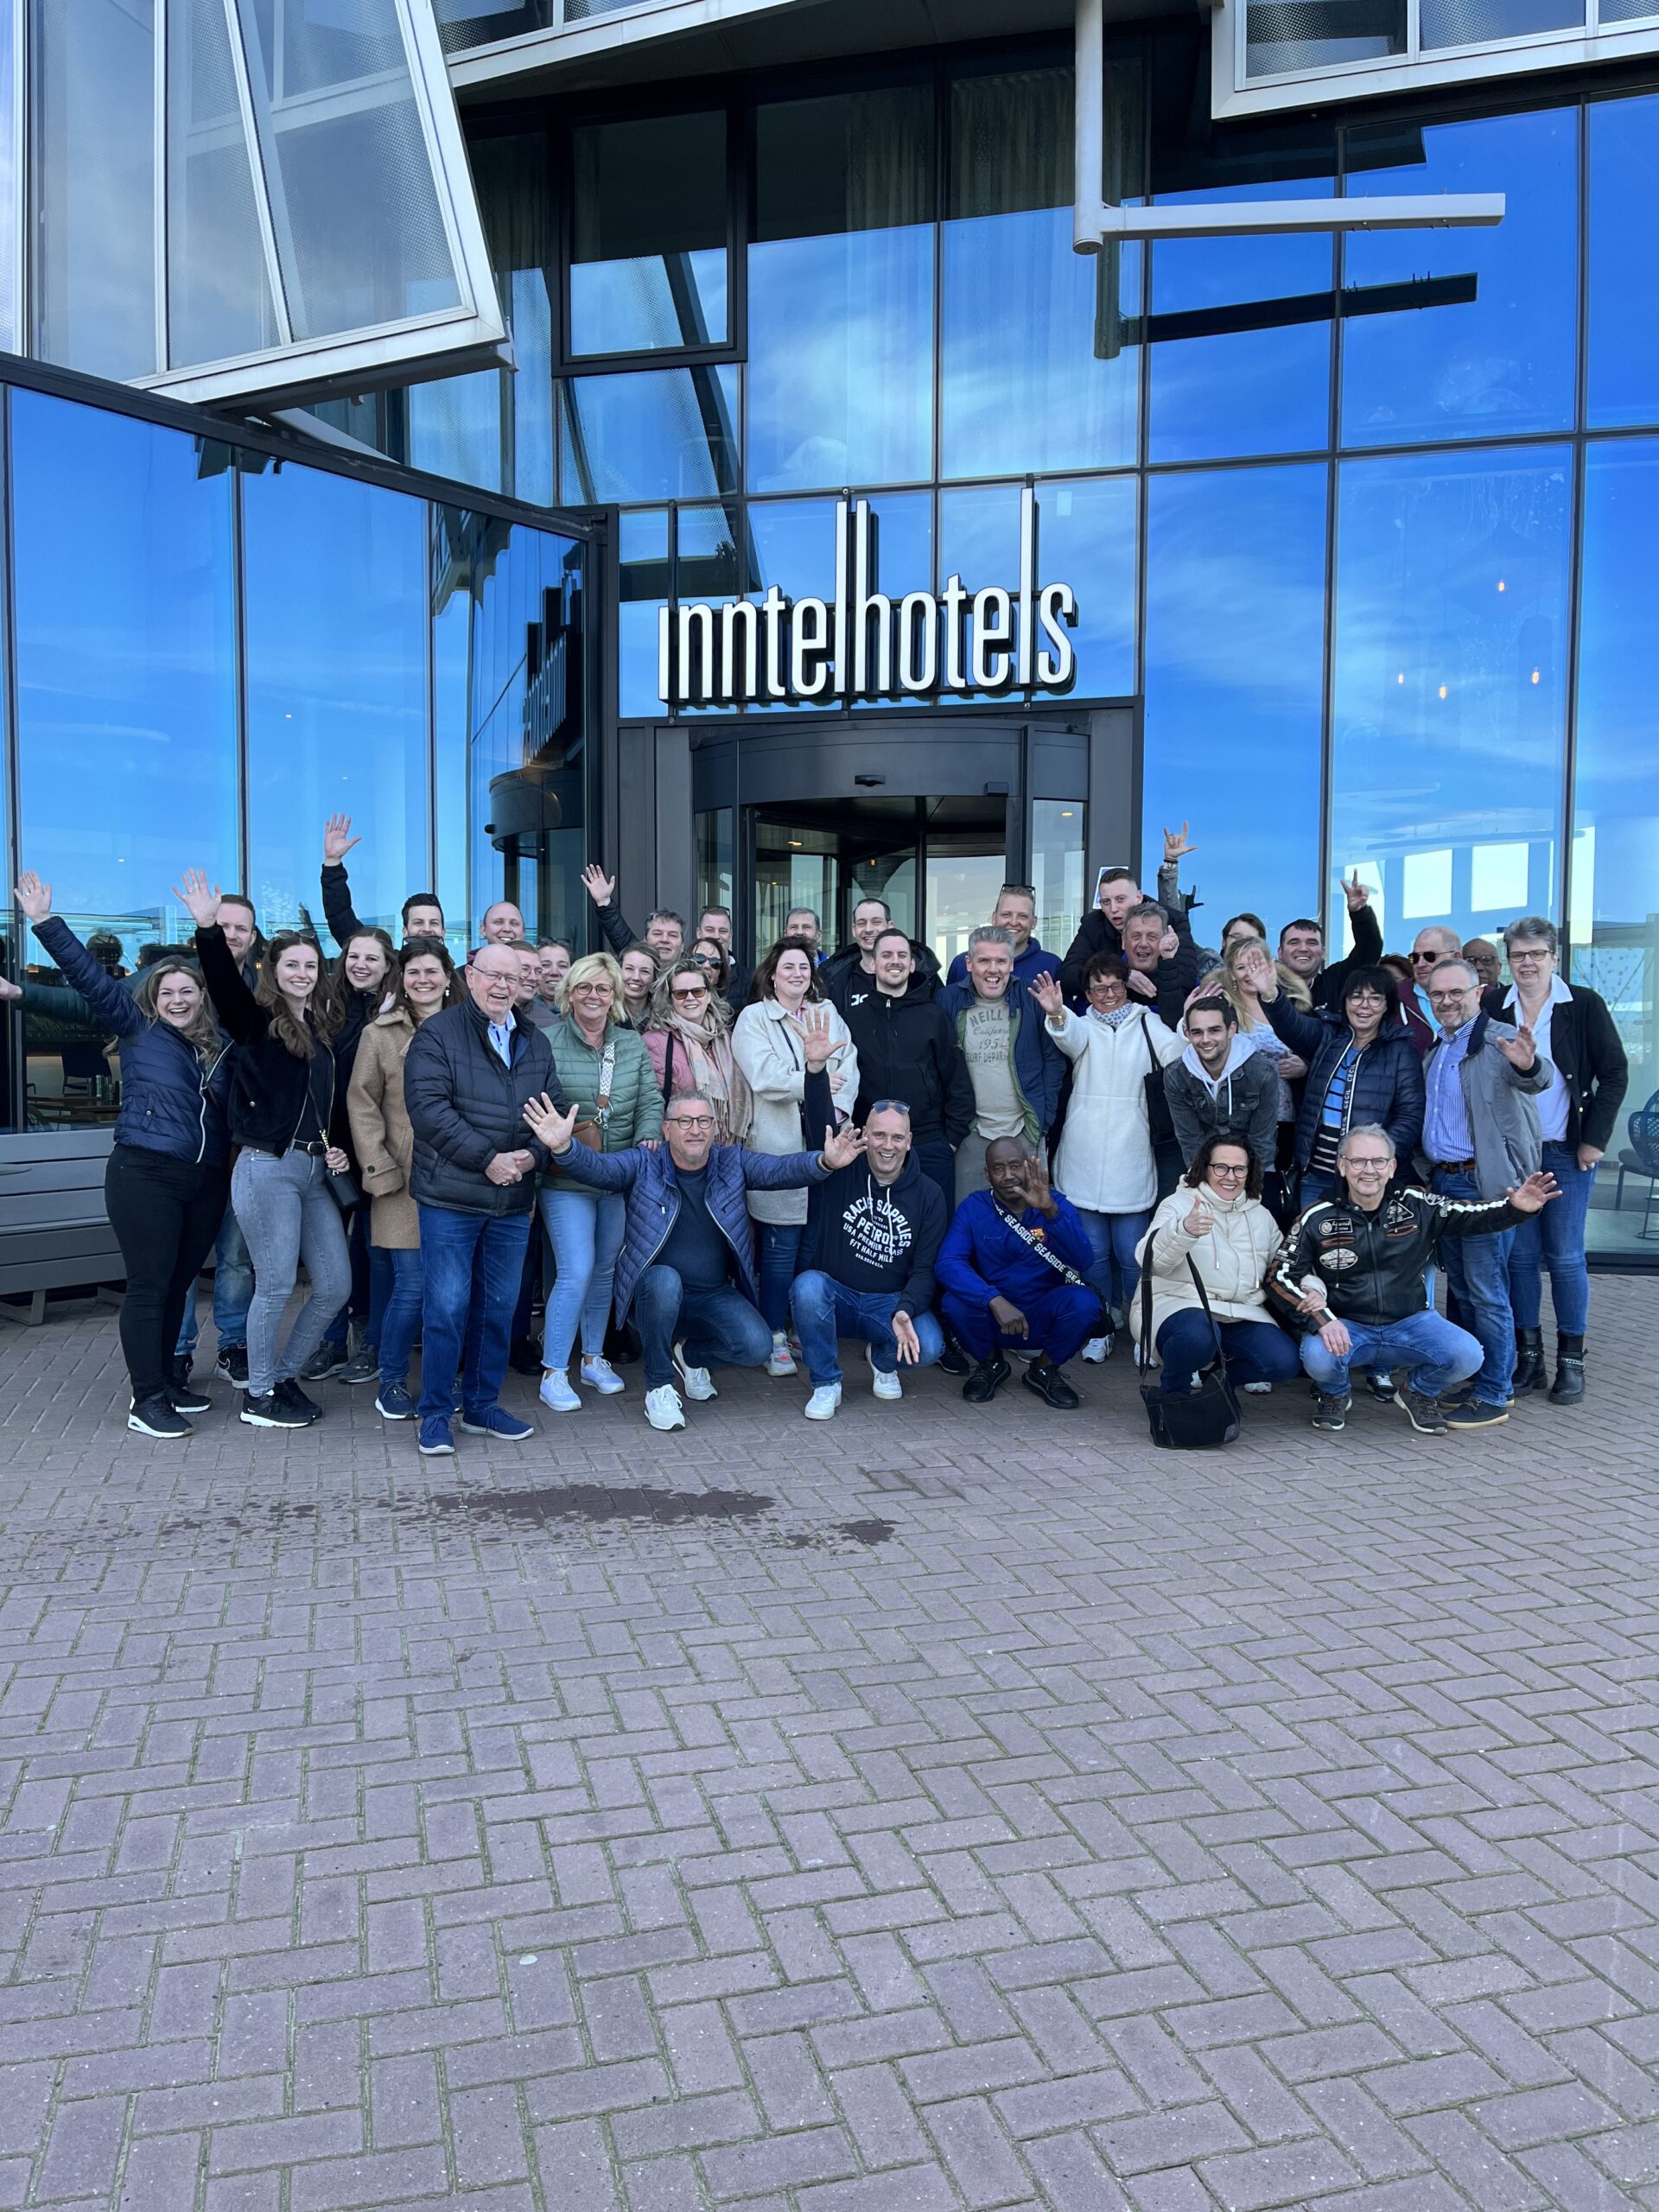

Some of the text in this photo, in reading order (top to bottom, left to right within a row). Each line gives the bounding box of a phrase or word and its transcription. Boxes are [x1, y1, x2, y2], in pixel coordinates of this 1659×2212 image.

[1343, 1089, 1351, 1109] CECIL
[843, 1223, 856, 1236] USA
[857, 1232, 882, 1251] PREMIER
[1004, 1214, 1036, 1245] SEASIDE
[1033, 1243, 1066, 1273] SEASIDE
[861, 1245, 878, 1259] HALF
[878, 1253, 894, 1263] MILE
